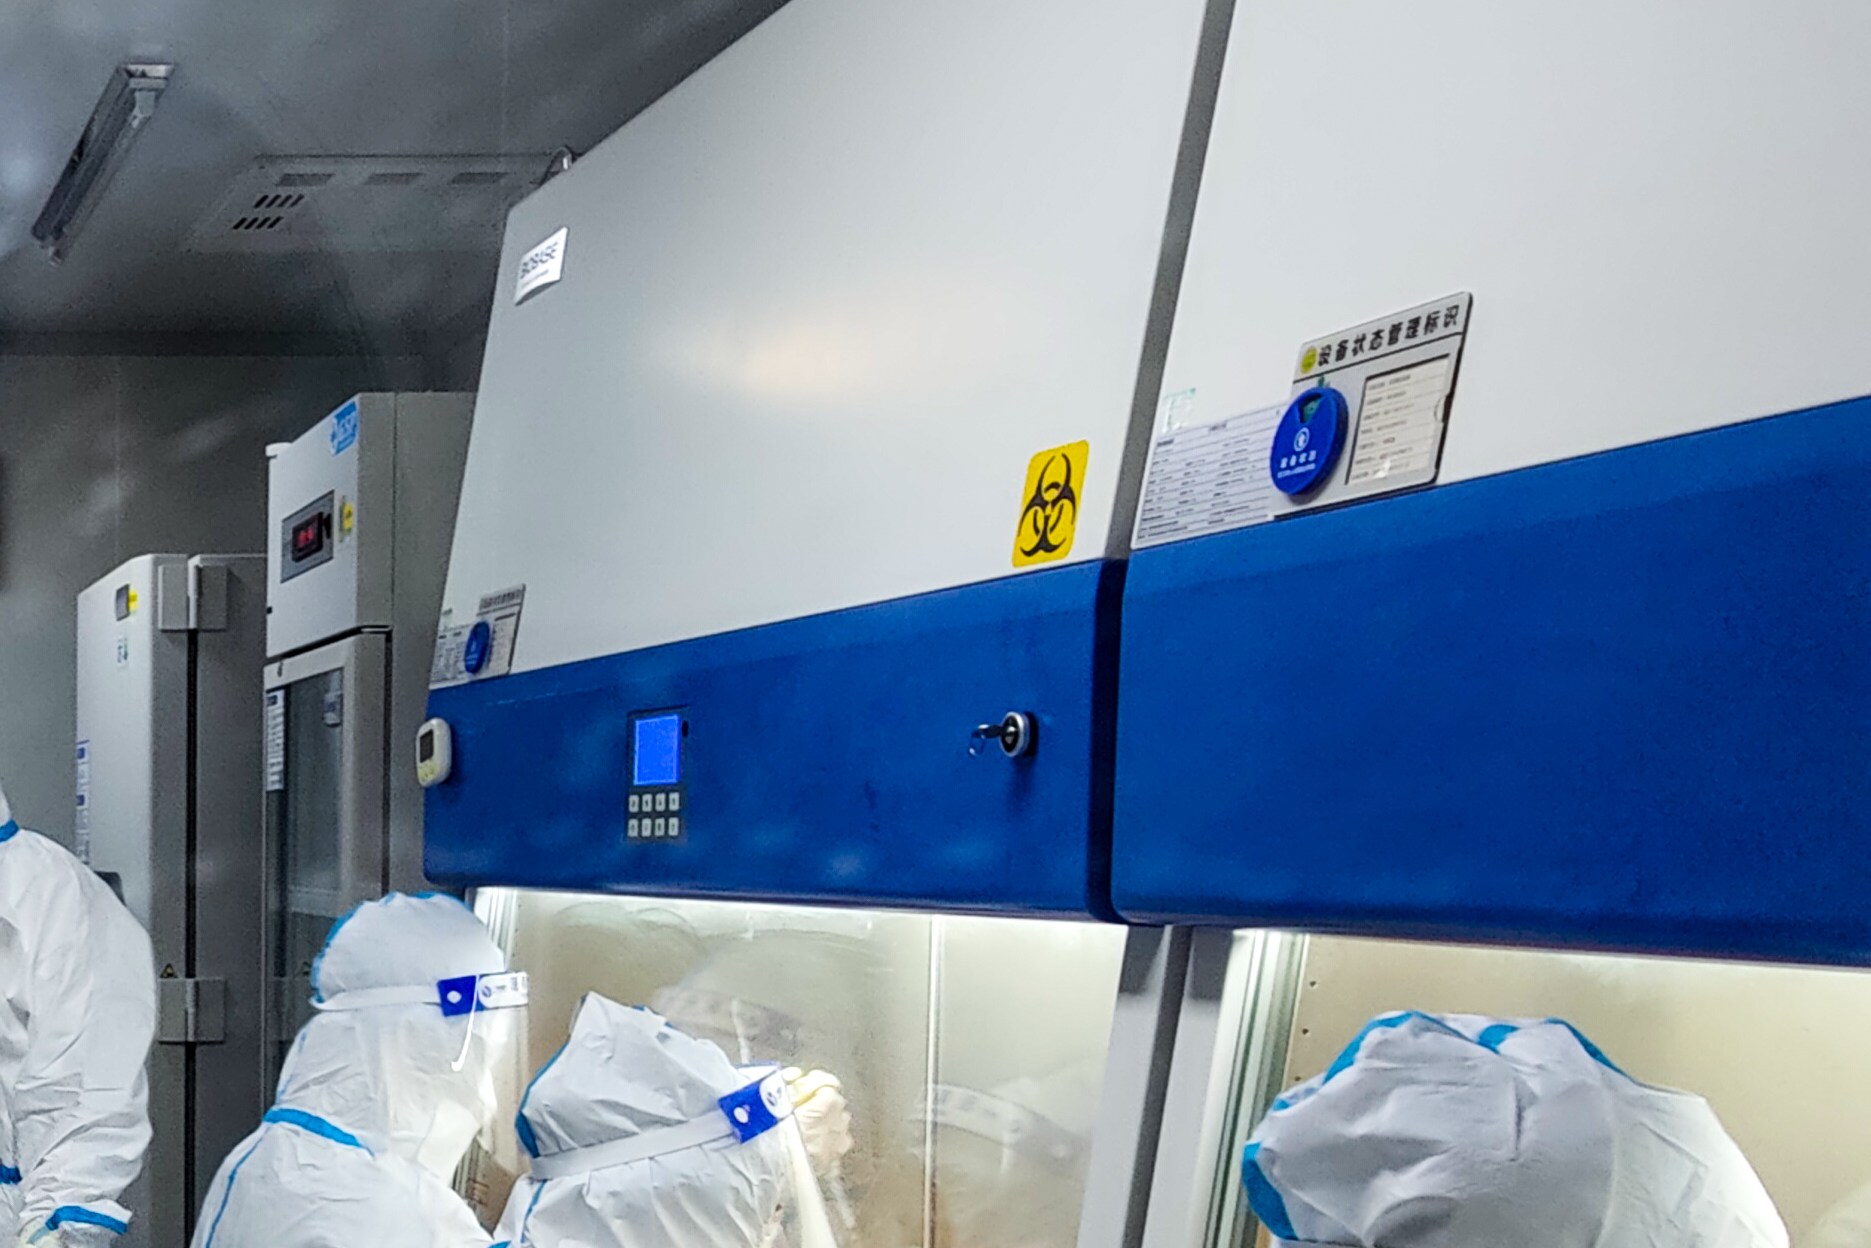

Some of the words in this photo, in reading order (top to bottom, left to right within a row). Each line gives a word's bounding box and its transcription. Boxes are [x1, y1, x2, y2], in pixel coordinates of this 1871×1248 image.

[1317, 304, 1460, 367] 设备状态管理标识
